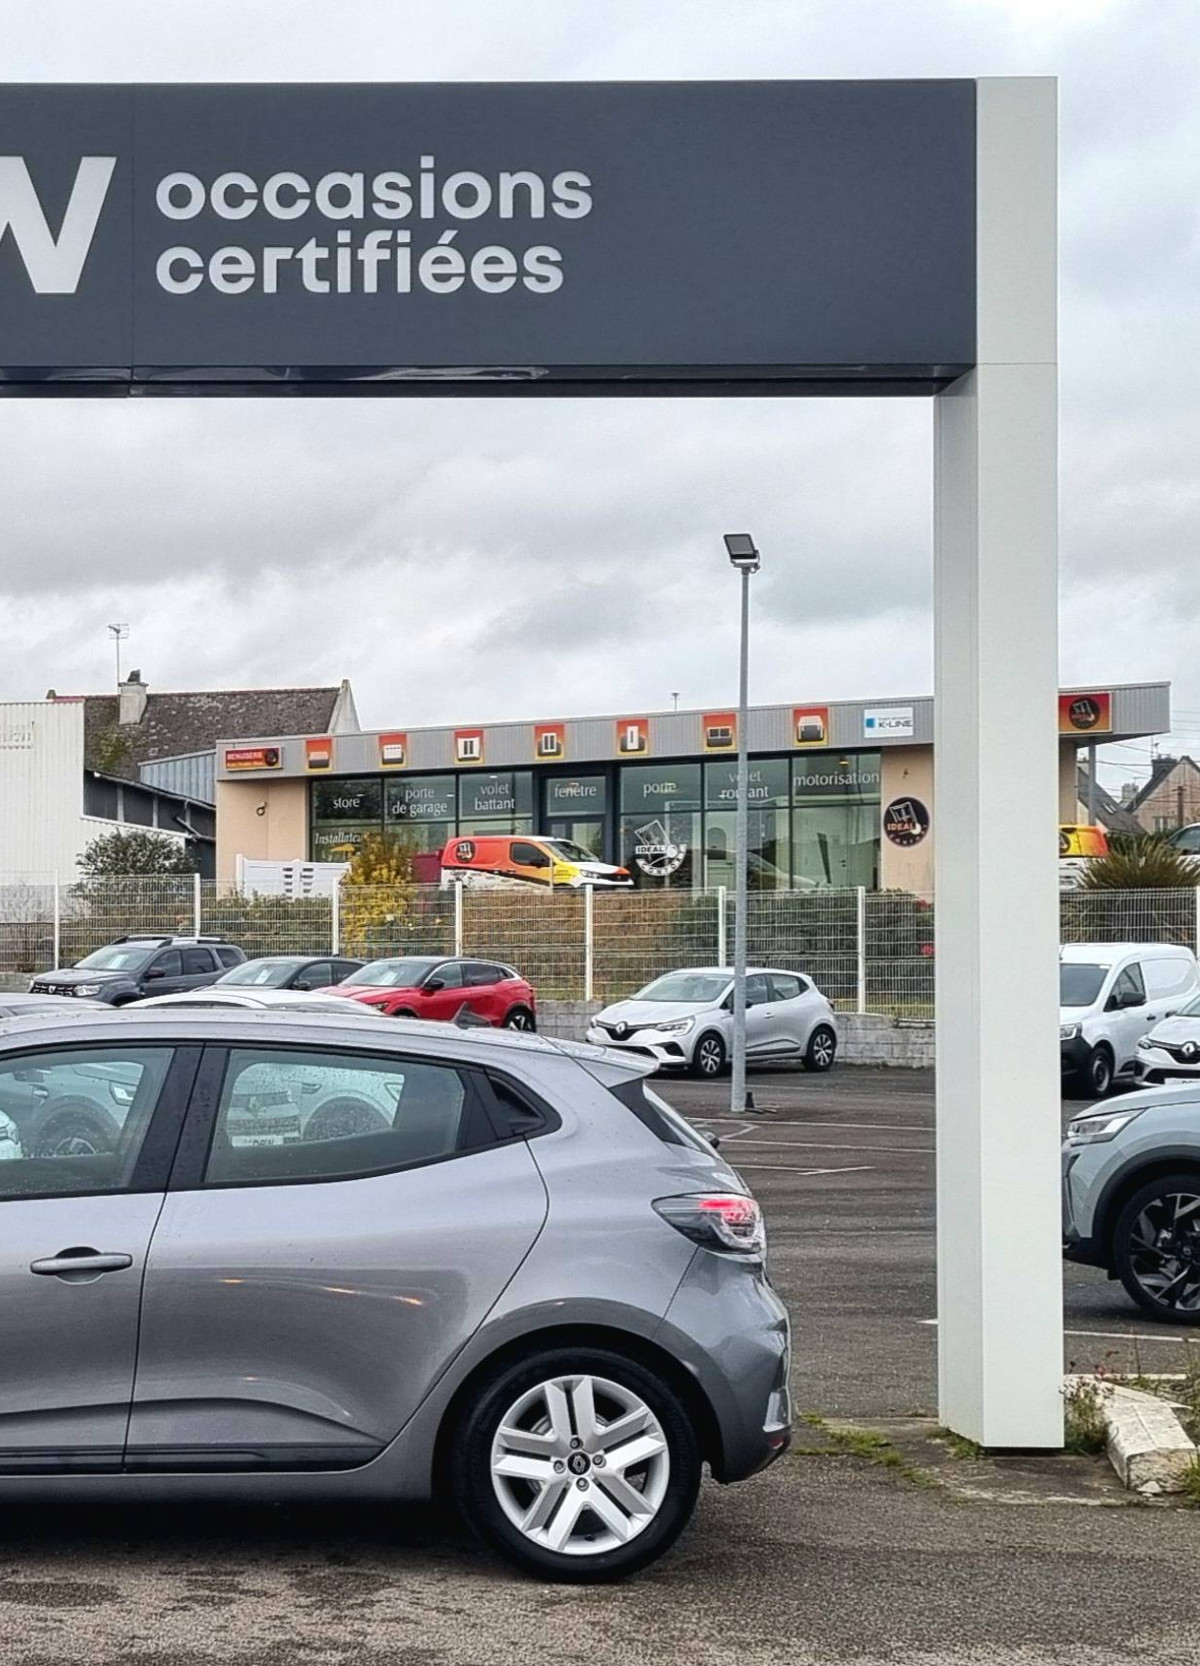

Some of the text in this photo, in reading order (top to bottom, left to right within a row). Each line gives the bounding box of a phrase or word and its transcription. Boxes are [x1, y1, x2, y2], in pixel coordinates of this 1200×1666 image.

[155, 155, 593, 219] occasions
[155, 229, 564, 294] certifiées
[729, 770, 761, 783] vet
[793, 770, 880, 786] motorisation
[405, 787, 435, 802] porte
[480, 782, 509, 796] volet
[643, 781, 676, 798] porte
[722, 785, 769, 799] roant
[333, 796, 361, 809] store
[392, 801, 407, 815] de
[474, 797, 516, 812] battant
[409, 802, 448, 818] garage
[887, 823, 915, 831] IDEAL
[637, 845, 665, 853] IDEAL
